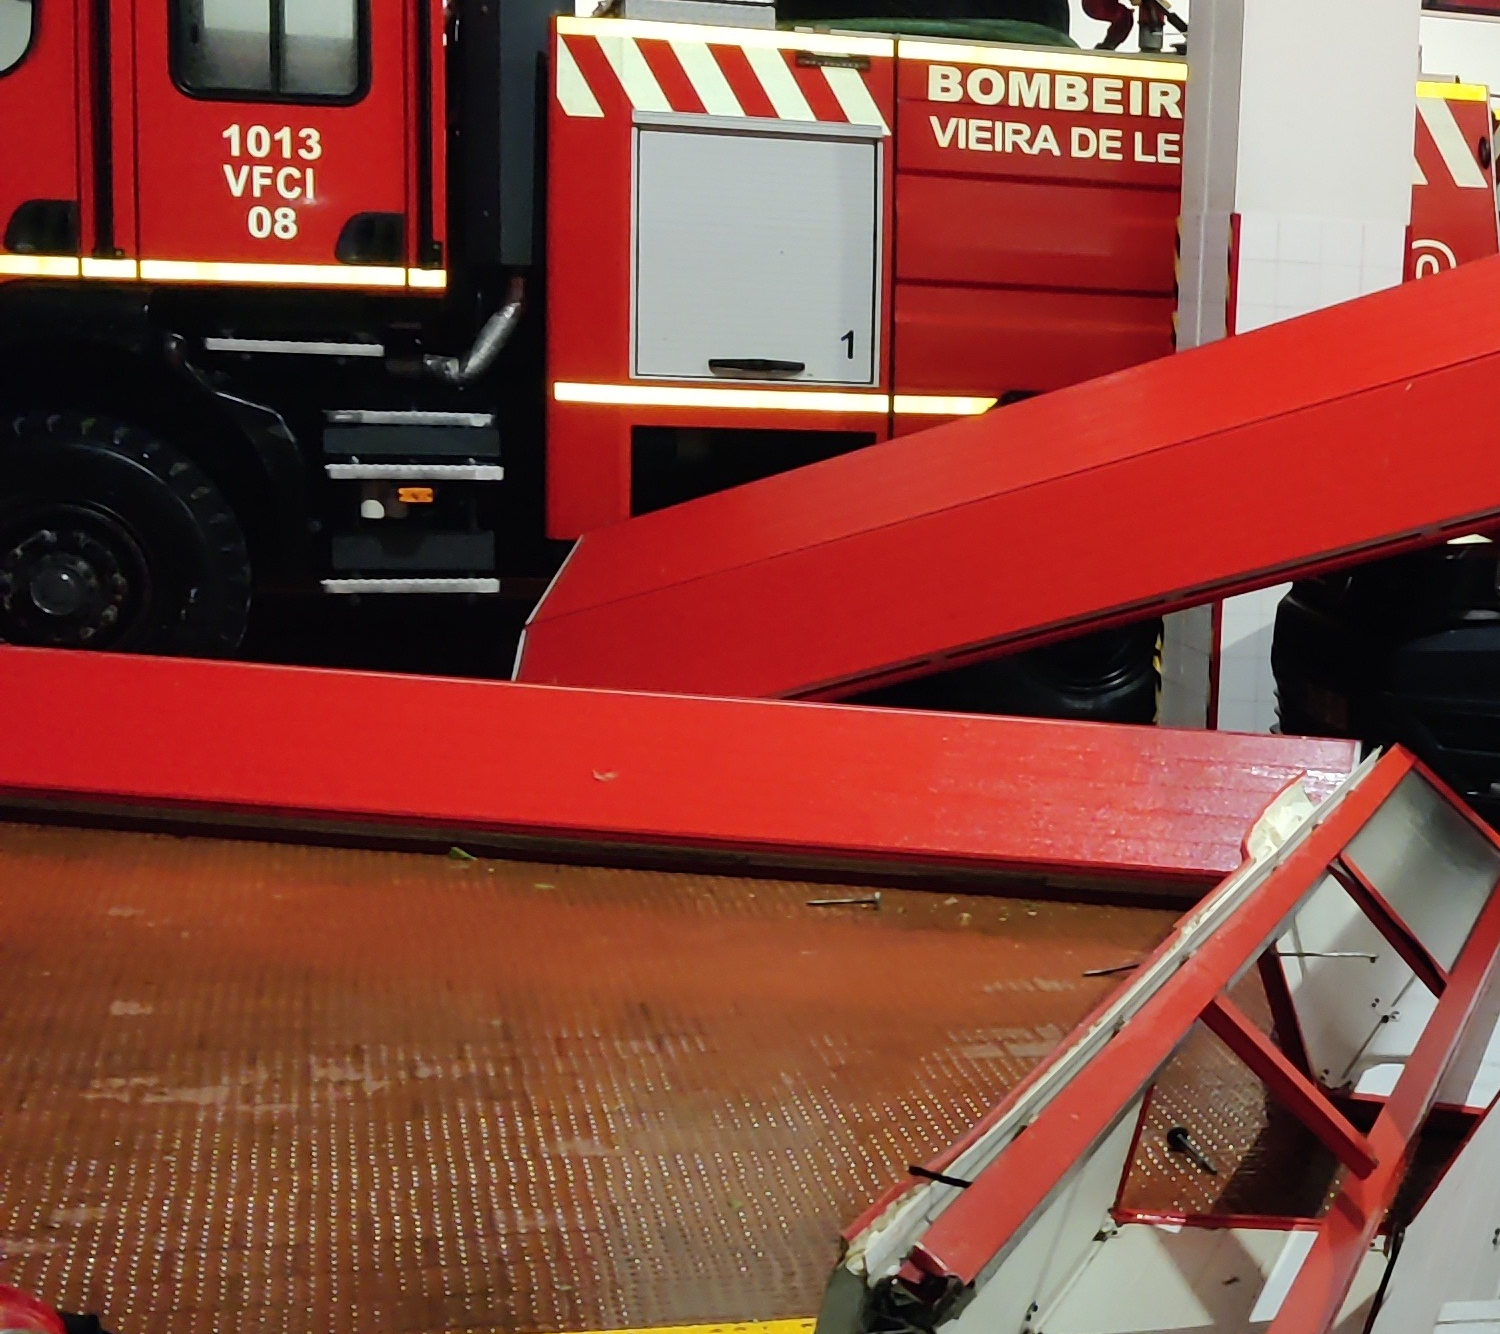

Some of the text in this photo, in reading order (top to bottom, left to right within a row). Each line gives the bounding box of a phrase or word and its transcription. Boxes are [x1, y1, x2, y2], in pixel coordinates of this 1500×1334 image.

[927, 64, 1183, 119] BOMBEIR
[222, 123, 322, 160] 1013
[929, 115, 1181, 164] VIEIRA DE LE
[223, 164, 315, 199] VFCI
[248, 206, 298, 239] 08
[840, 329, 854, 360] 1
